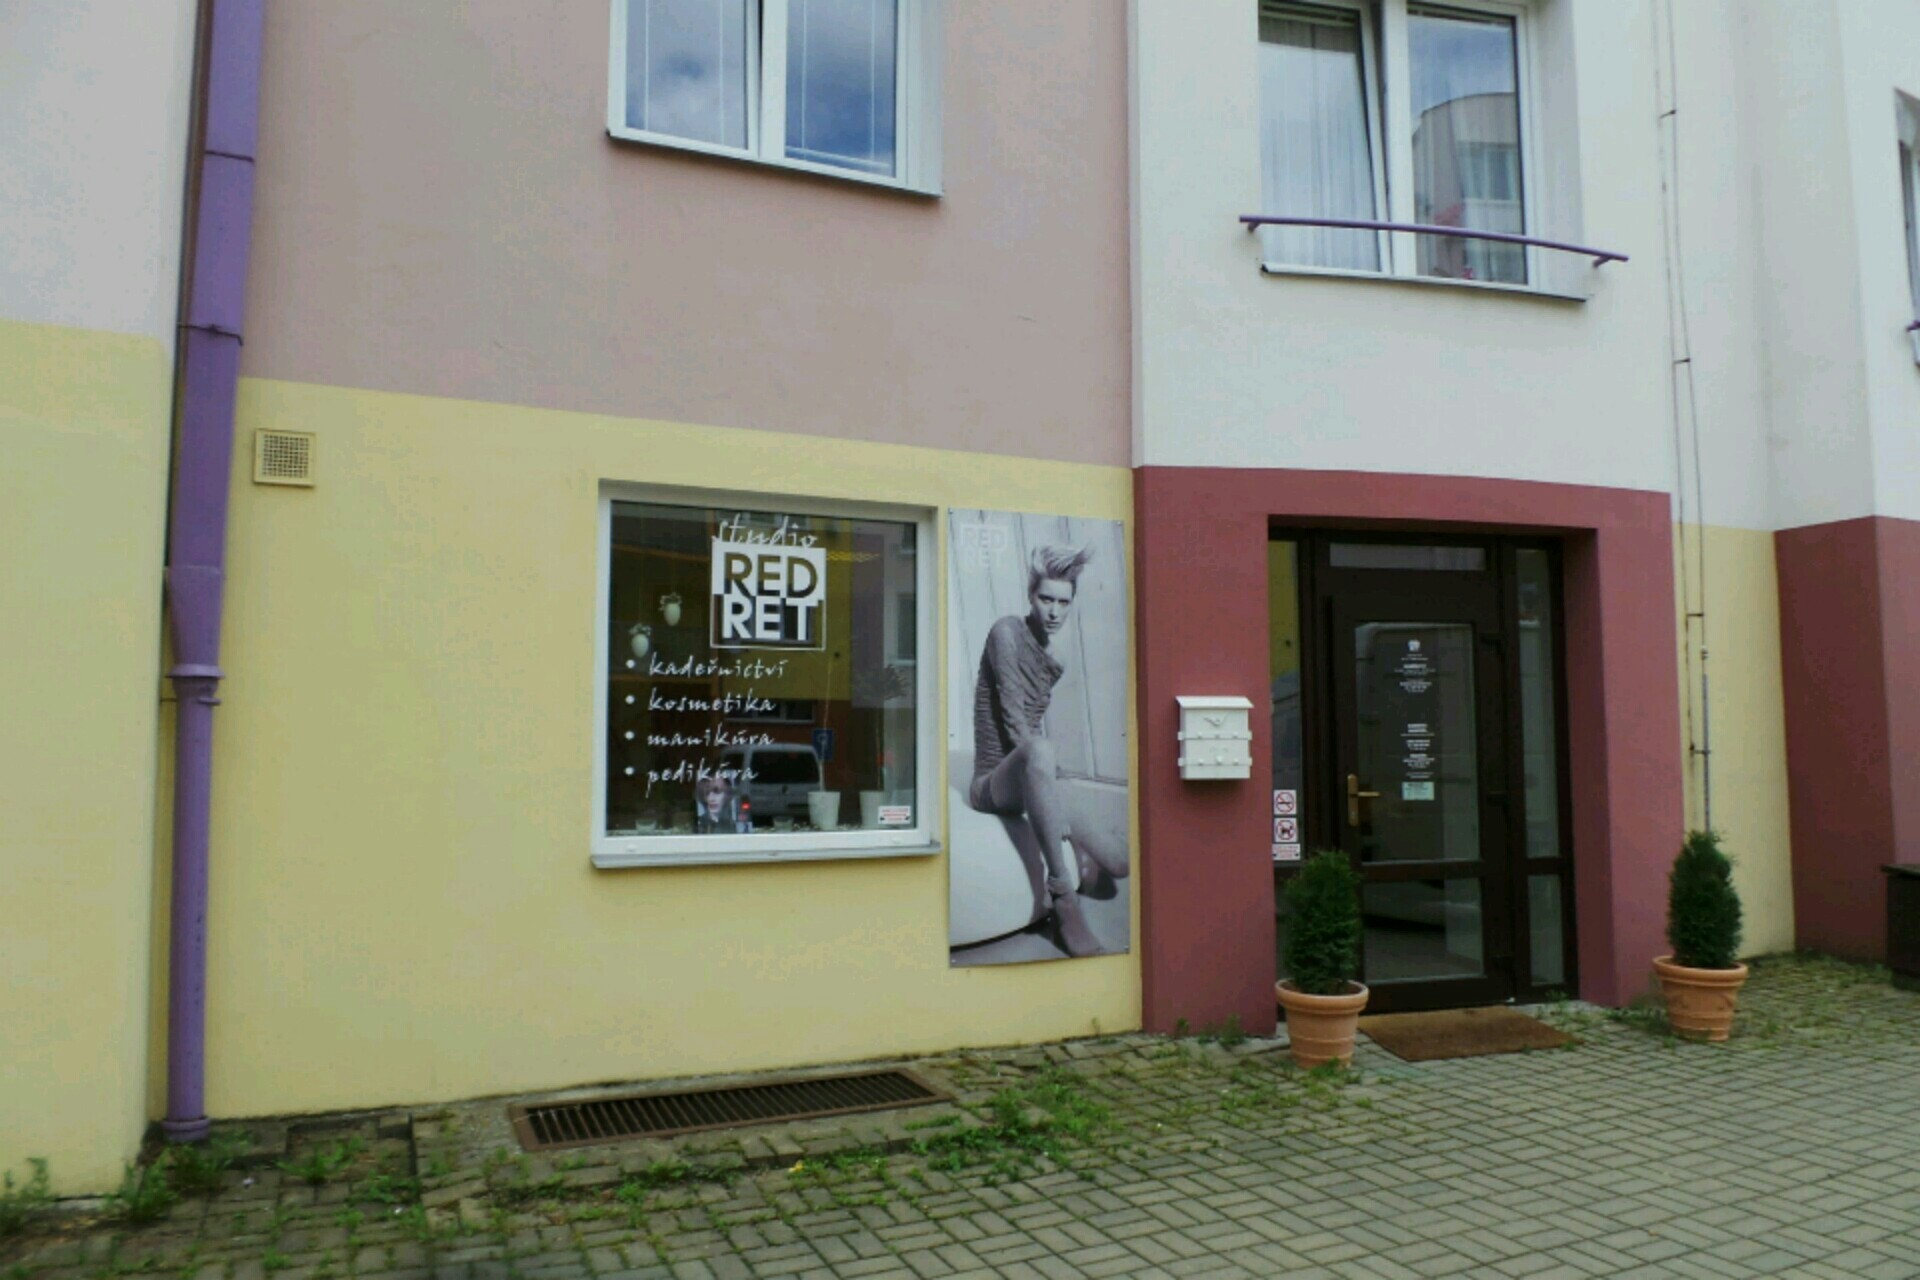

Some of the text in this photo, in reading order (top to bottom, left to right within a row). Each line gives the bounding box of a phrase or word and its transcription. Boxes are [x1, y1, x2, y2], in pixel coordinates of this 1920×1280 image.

[712, 513, 818, 548] studio
[724, 552, 818, 598] RED
[722, 594, 818, 641] RET
[650, 652, 788, 678] kadeřnictví
[648, 688, 776, 713] kosmetika
[648, 722, 774, 747] manikúra
[645, 757, 758, 799] pedikúra
